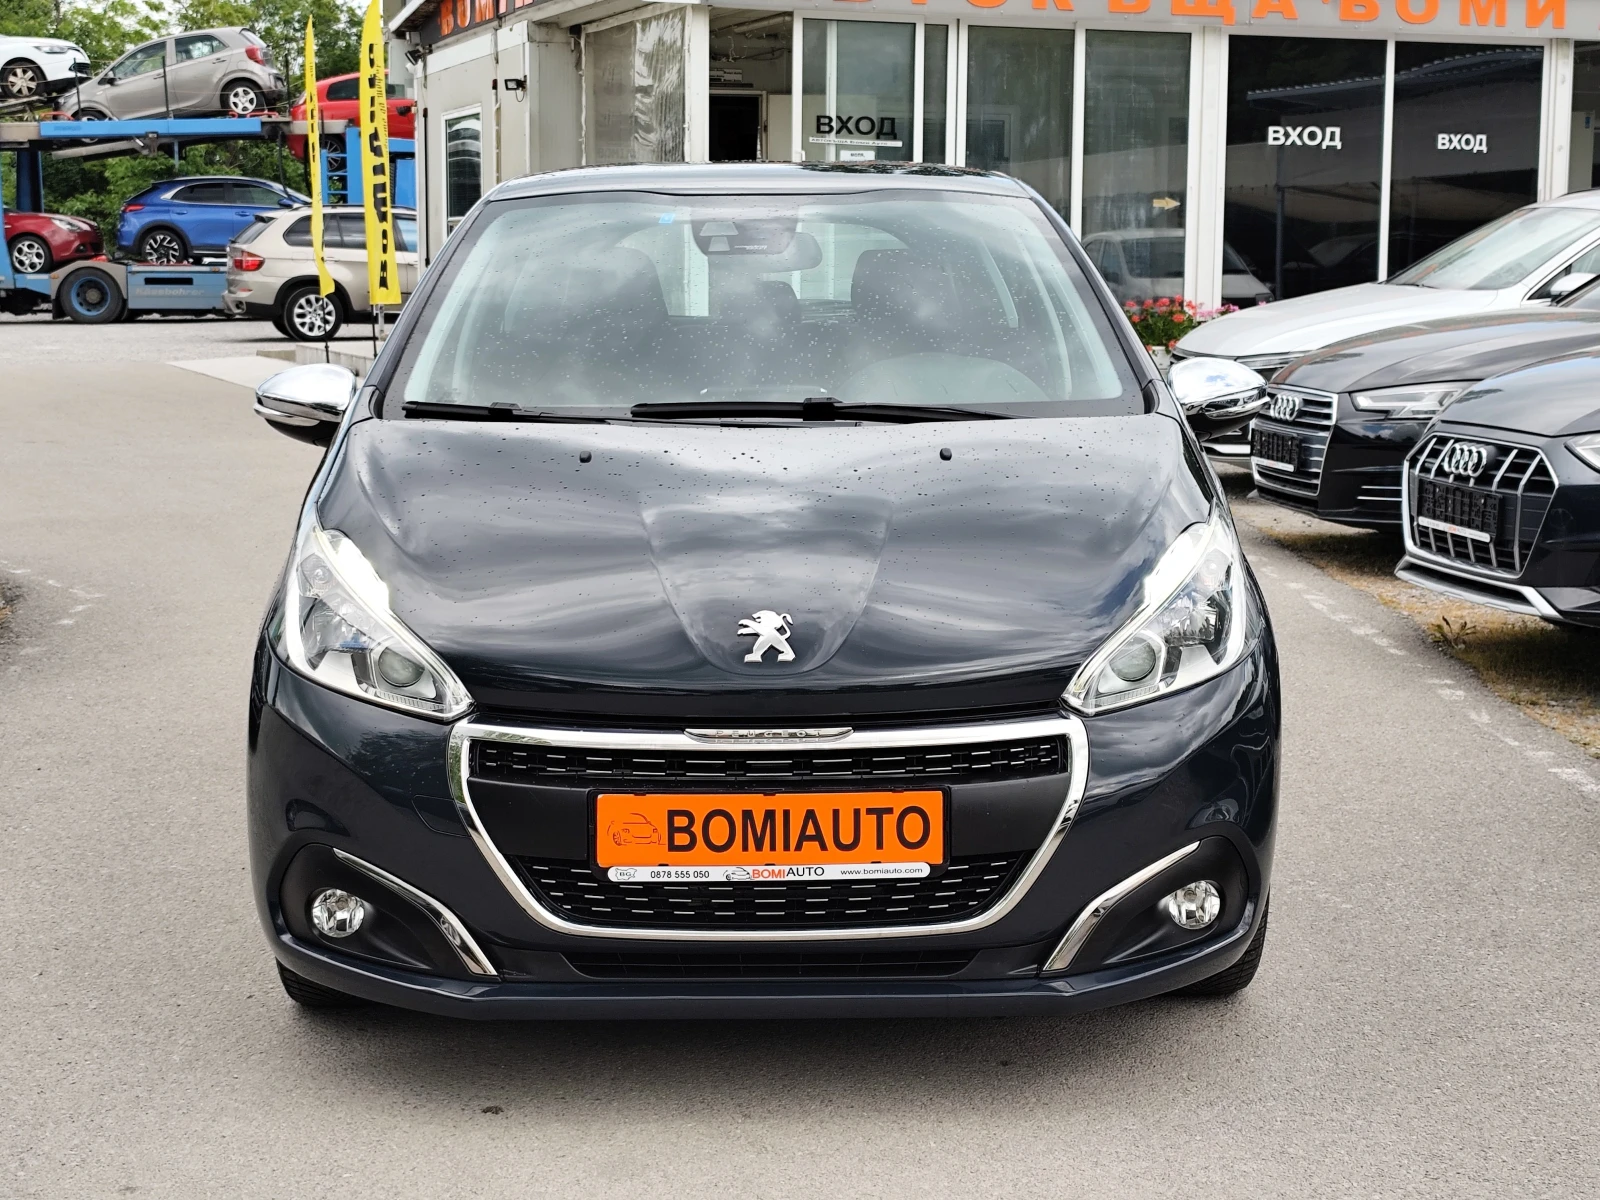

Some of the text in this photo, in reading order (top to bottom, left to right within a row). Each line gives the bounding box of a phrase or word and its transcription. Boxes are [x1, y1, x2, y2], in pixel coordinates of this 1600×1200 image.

[816, 115, 897, 140] ВХОД
[1267, 126, 1342, 150] ВХОД
[1436, 133, 1488, 153] ВХОД
[715, 730, 821, 738] PEUGEOT
[666, 805, 931, 853] BOMIAUTO
[650, 870, 710, 879] 0878 555 050
[840, 867, 923, 875] www.bomiauto.com
